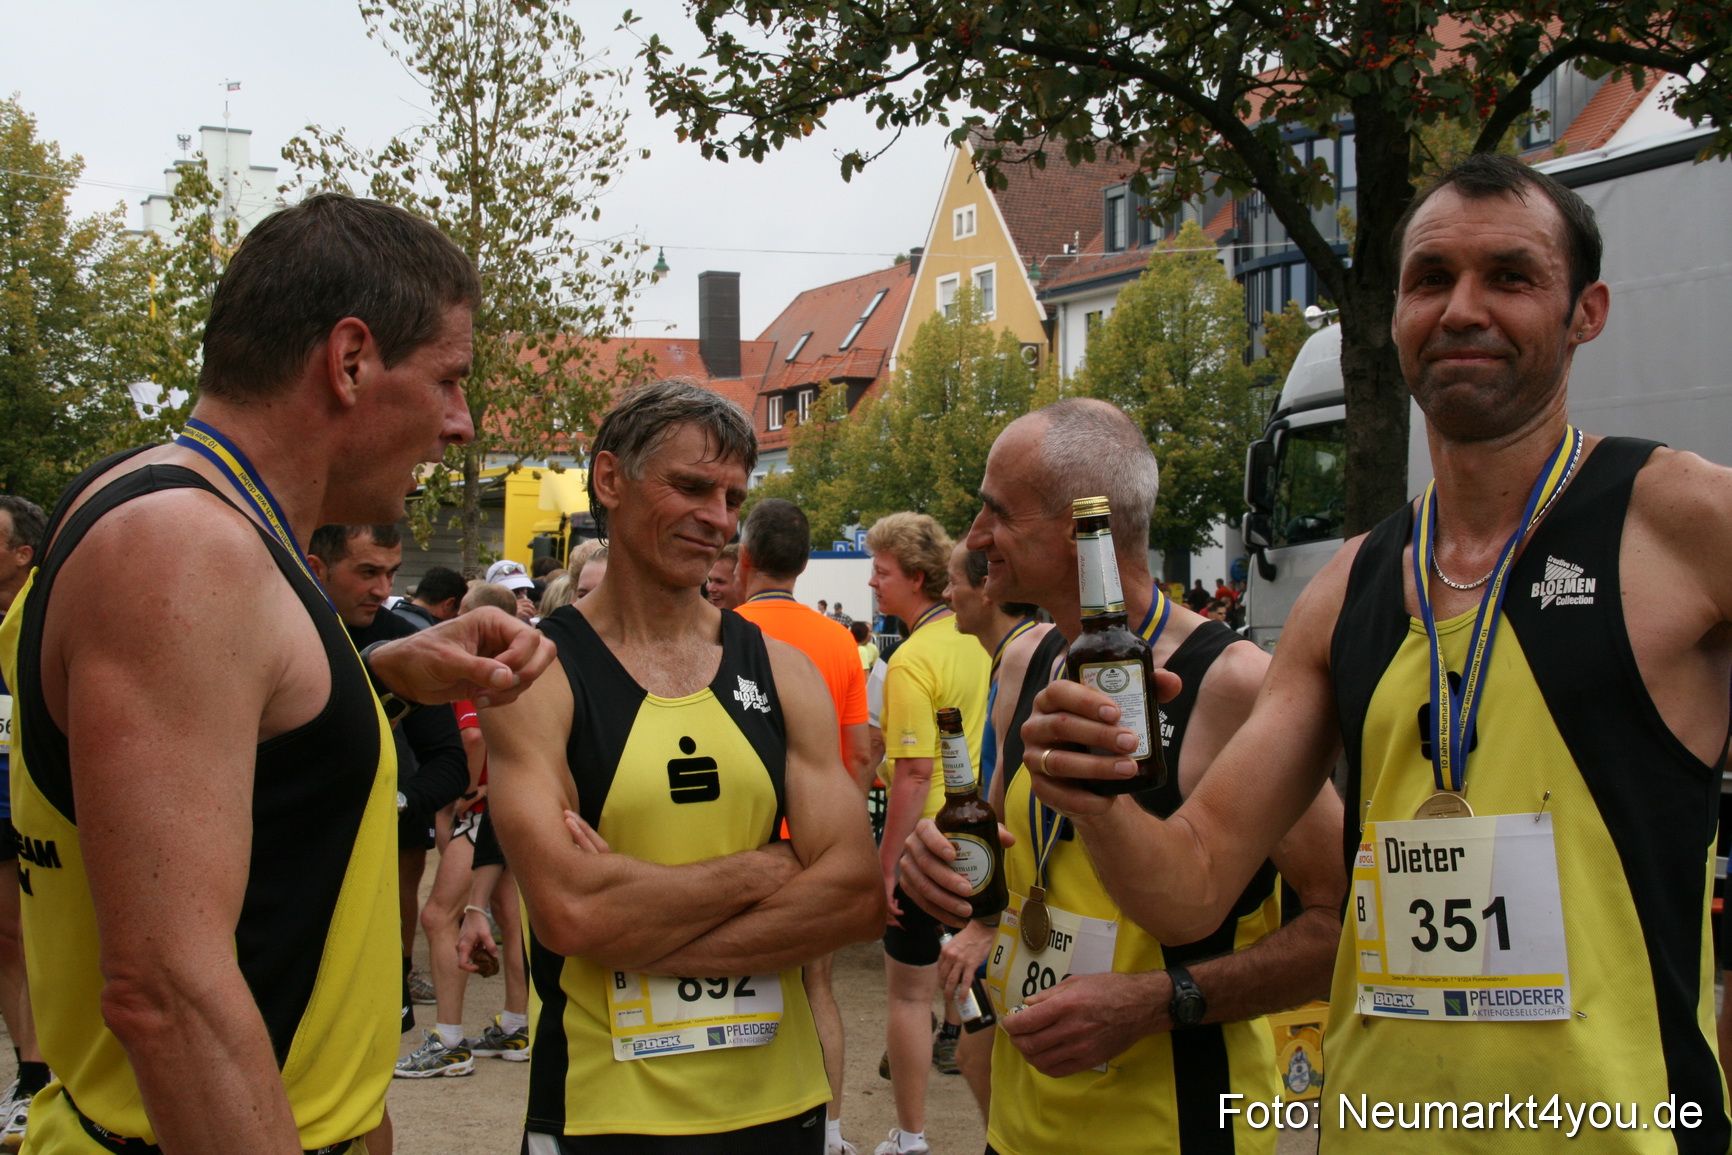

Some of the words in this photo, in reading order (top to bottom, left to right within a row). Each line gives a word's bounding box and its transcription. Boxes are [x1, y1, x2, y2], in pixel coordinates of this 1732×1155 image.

[238, 472, 257, 497] dabei
[255, 494, 267, 508] war
[266, 507, 275, 520] ich
[1547, 555, 1571, 569] Creative
[1571, 562, 1585, 574] Line
[1531, 577, 1596, 598] BLOEMEN
[1555, 594, 1594, 606] Collection
[1481, 628, 1488, 638] 10
[1475, 639, 1486, 659] Jahre
[1465, 660, 1480, 705] Neumarkter
[733, 690, 768, 705] BLOEEN
[1440, 691, 1448, 735] Neumarkter
[1440, 736, 1448, 759] Jahre
[1441, 760, 1448, 769] 10
[1385, 837, 1465, 873] Dieter
[1357, 896, 1366, 922] B
[1408, 896, 1511, 952] 351
[1048, 928, 1073, 952] ner
[993, 945, 1004, 965] B
[614, 971, 626, 990] B
[677, 975, 757, 1002] 892
[1022, 961, 1073, 998] 89
[1373, 992, 1415, 1008] BOCK
[1469, 988, 1565, 1006] PFLEIDERER
[1472, 1007, 1565, 1017] AKTIENGESELLSCHAFT
[633, 1035, 681, 1051] BOCK
